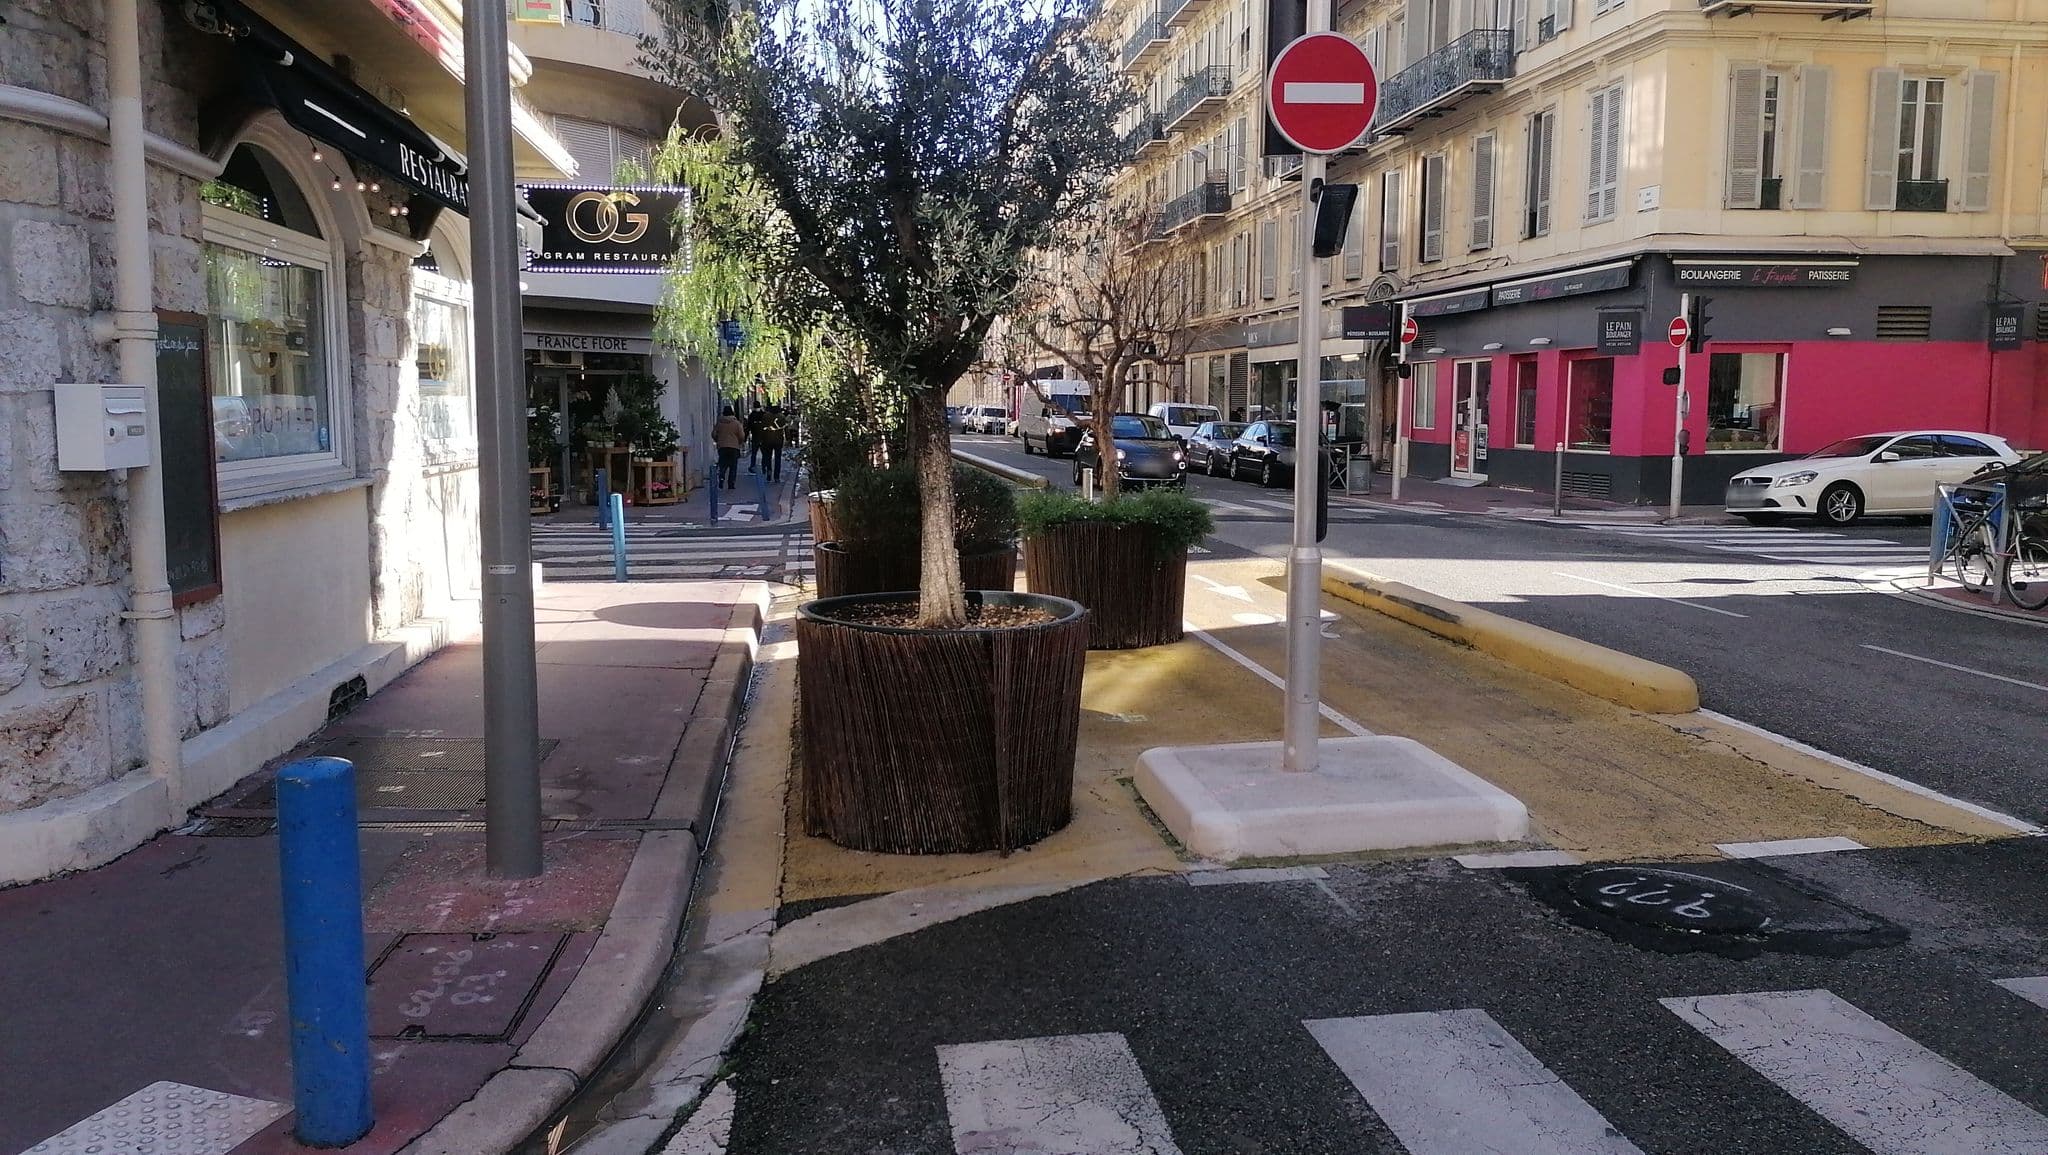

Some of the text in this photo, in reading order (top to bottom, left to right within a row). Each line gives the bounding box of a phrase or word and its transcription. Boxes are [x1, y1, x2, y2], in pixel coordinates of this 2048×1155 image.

[400, 142, 469, 207] RESTAURA
[565, 191, 649, 244] OG
[594, 253, 681, 262] RESTAURAN
[1680, 270, 1742, 280] BOULANGERIE
[1808, 271, 1850, 281] PATISSERIE
[1606, 321, 1632, 331] LE PAIN
[2003, 317, 2017, 326] PAIN
[537, 335, 588, 350] FRANCE
